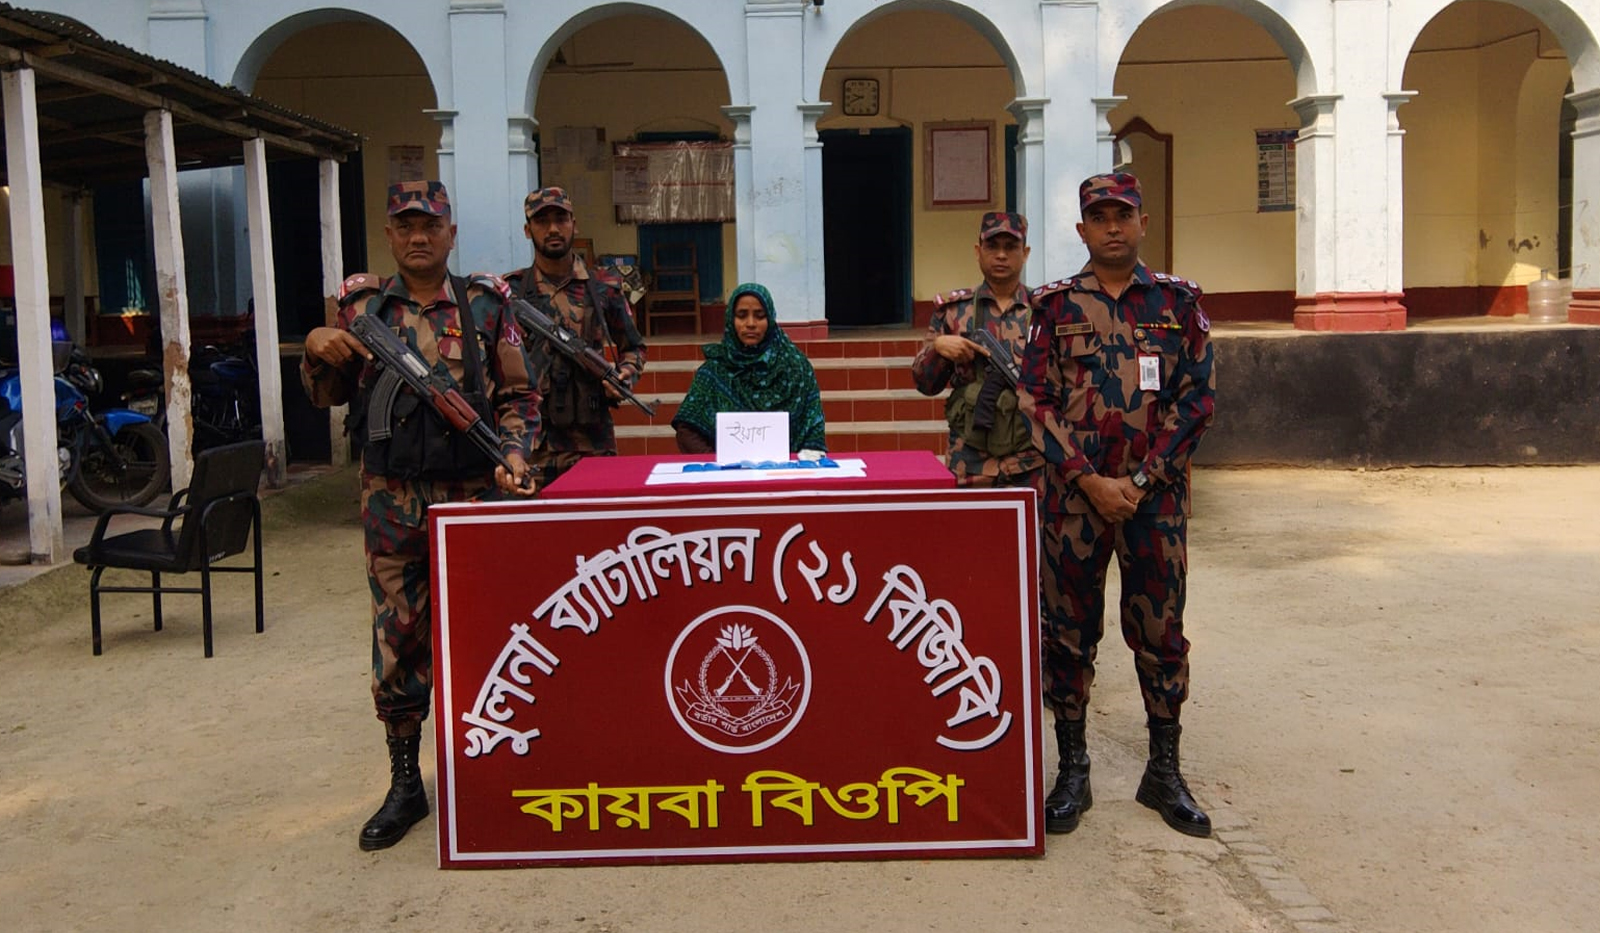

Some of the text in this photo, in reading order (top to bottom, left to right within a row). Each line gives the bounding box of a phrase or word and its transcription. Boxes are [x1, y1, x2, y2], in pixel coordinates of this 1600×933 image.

[461, 523, 1012, 757] খুলনা ব্যাটালিয়ন (২১ বিজিবি)
[512, 766, 965, 832] কায়বা বিওপি
